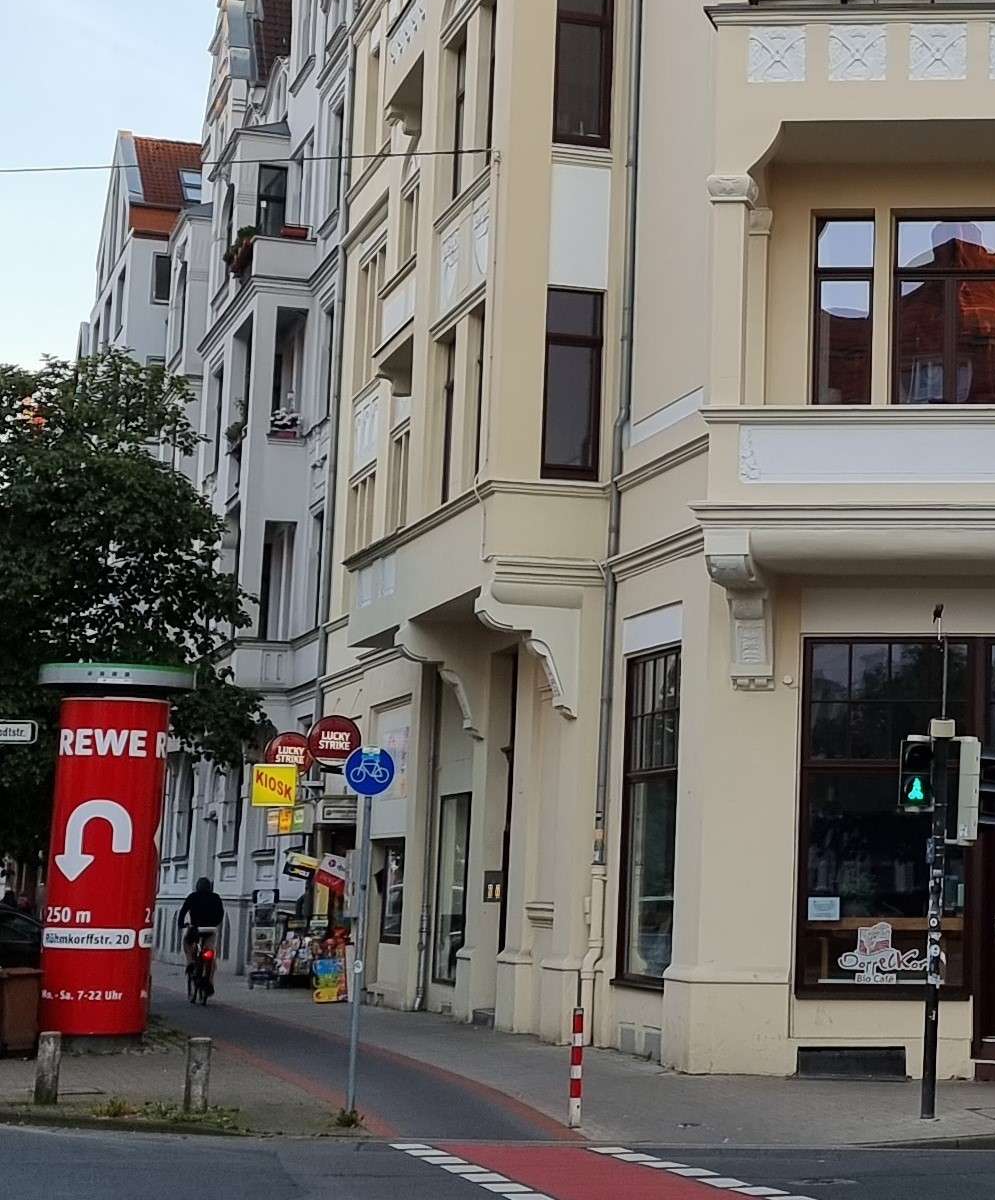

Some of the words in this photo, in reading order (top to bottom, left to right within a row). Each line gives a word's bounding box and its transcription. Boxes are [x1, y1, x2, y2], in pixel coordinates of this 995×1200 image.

[321, 730, 350, 742] LUCKY
[59, 728, 148, 758] REWE
[318, 740, 351, 751] STRIKE
[277, 745, 305, 755] LUCKY
[275, 754, 305, 765] STRIKE
[255, 768, 292, 801] KIOSK
[46, 906, 72, 923] 250
[75, 910, 92, 924] m
[116, 934, 130, 945] 20
[856, 974, 871, 984] Bio
[77, 990, 101, 1000] 7-22
[104, 990, 123, 1000] Uhr
